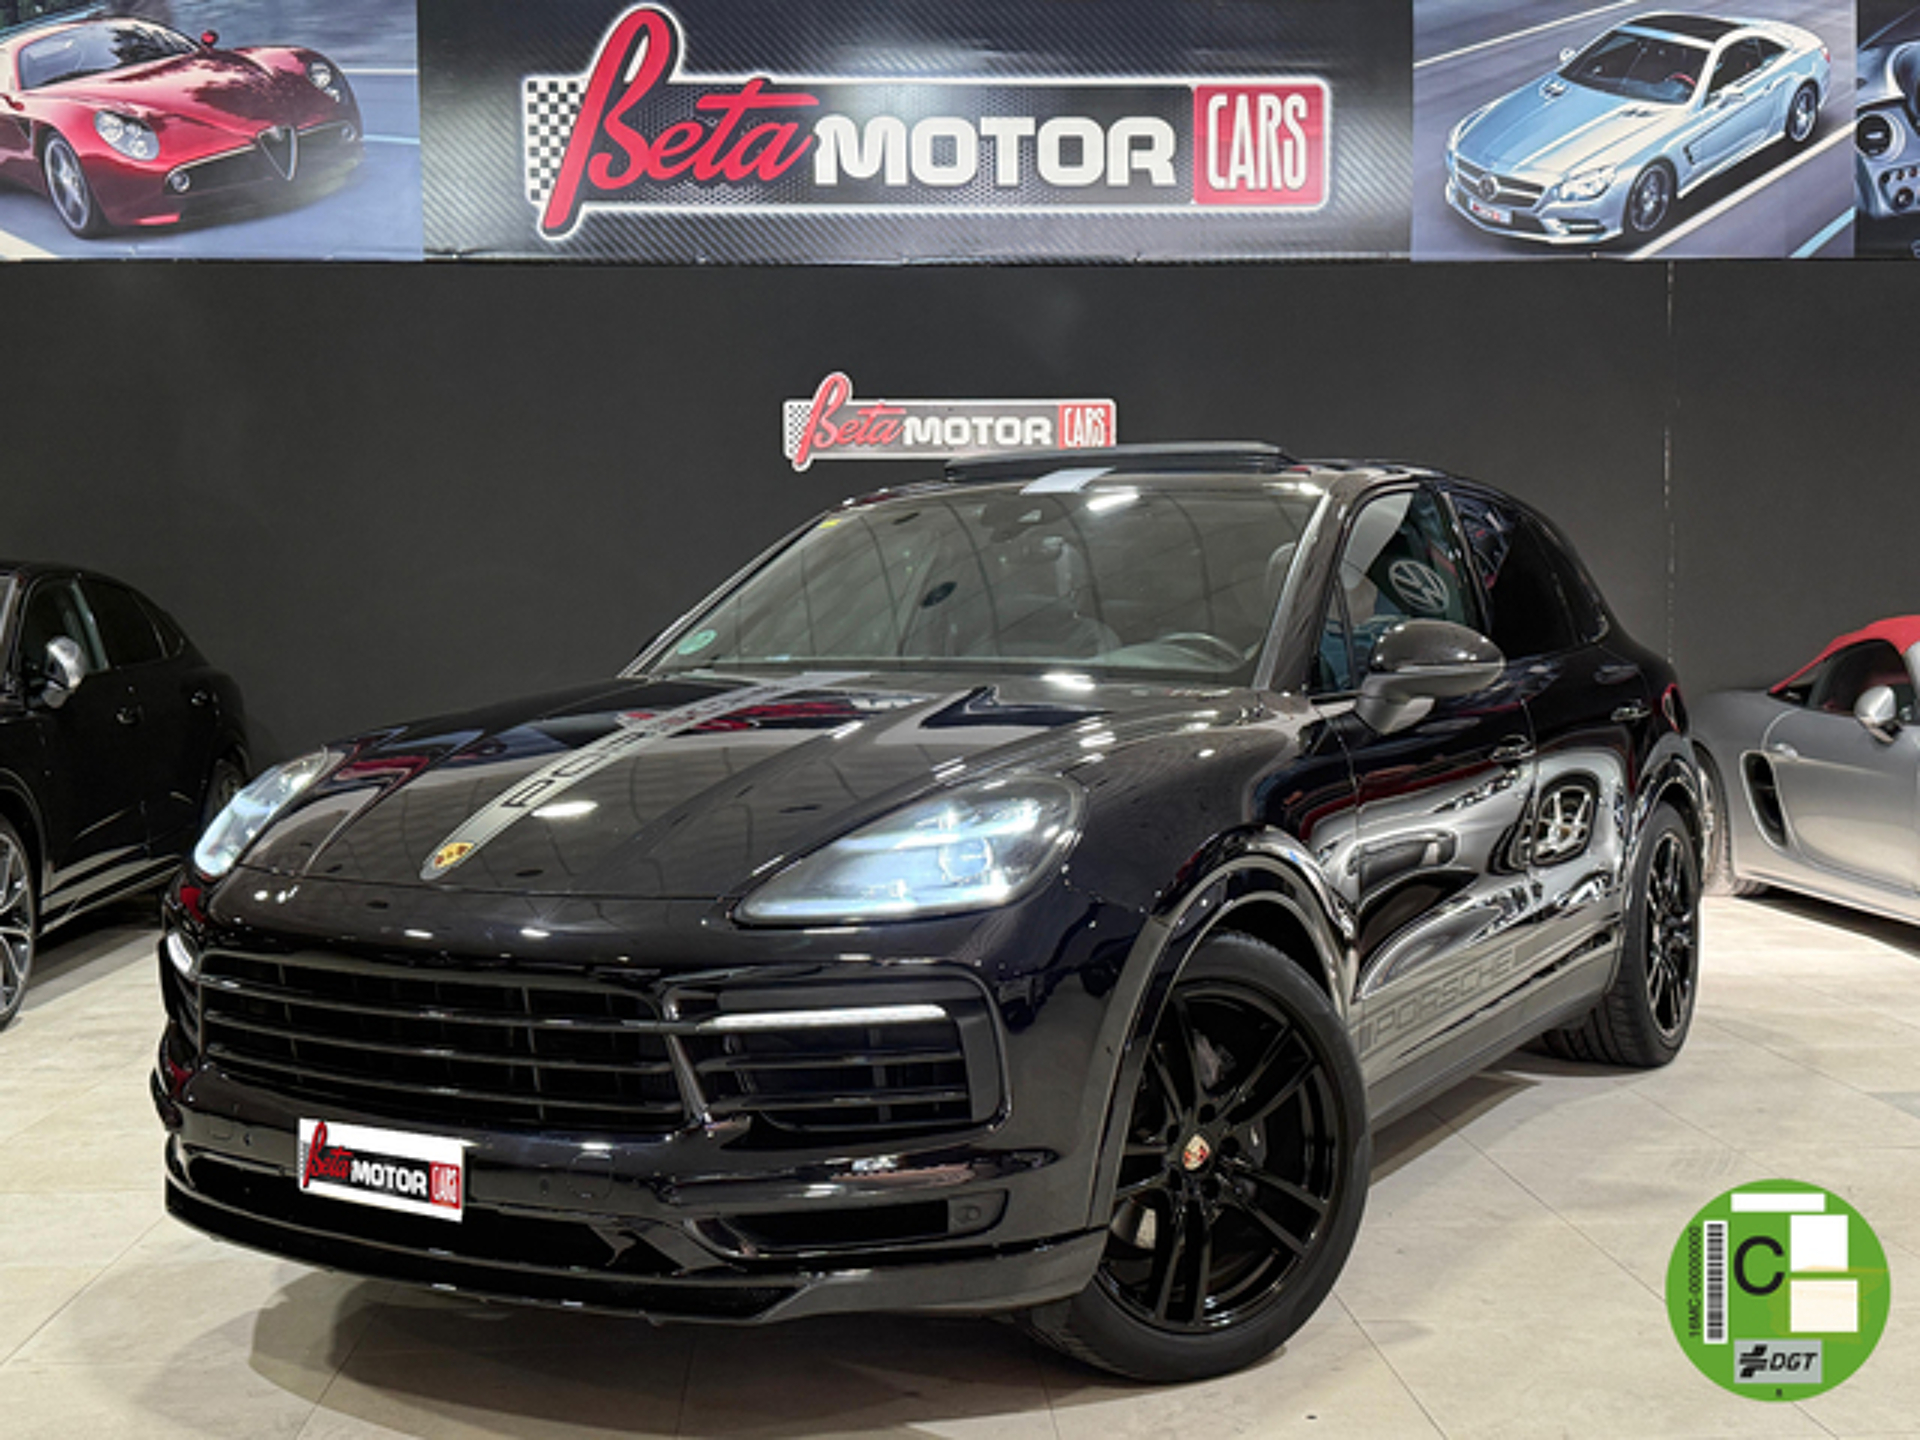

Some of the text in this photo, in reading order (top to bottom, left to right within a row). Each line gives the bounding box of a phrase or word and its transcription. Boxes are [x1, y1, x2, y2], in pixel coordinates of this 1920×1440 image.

[814, 115, 1177, 187] MOTOR
[1207, 93, 1308, 190] CARS
[903, 416, 1053, 445] MOTOR
[1064, 407, 1106, 447] CARS
[1373, 950, 1511, 1045] PORSCHE
